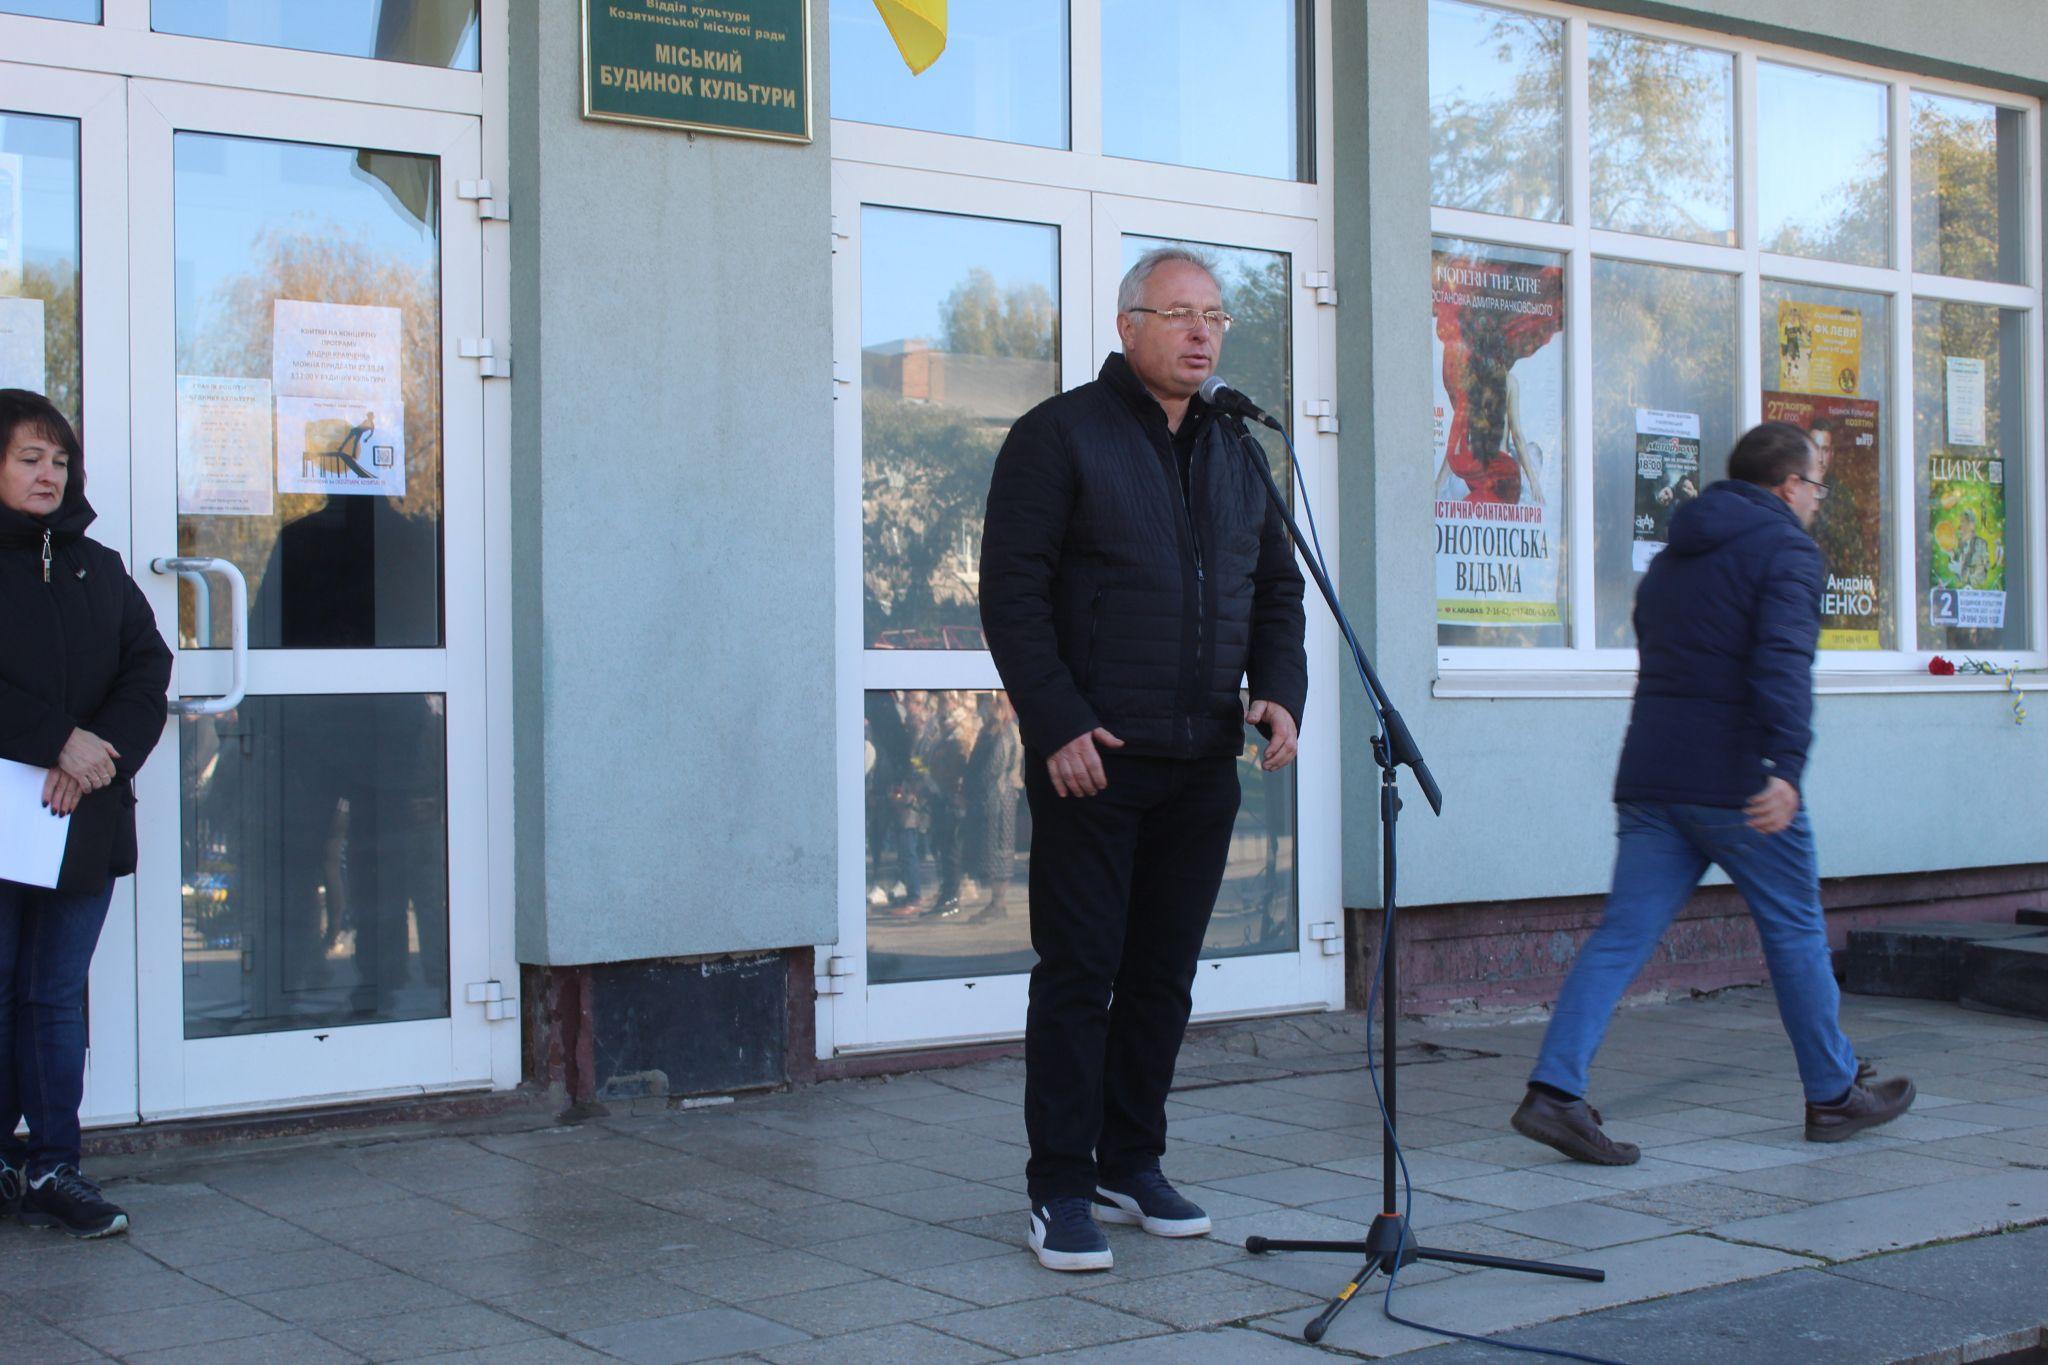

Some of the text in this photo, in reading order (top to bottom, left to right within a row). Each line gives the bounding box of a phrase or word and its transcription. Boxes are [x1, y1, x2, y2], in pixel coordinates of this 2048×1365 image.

[646, 0, 750, 22] Відділ культури
[609, 6, 786, 42] Козятинської міської ради
[656, 43, 742, 74] МІСЬКИЙ
[601, 65, 796, 109] БУДИНОК КУЛЬТУРИ
[1437, 266, 1542, 295] MODERN THEATRE
[1472, 295, 1499, 310] ДМИТРА
[1500, 299, 1553, 317] РАЧКОВСЬКОГО
[1933, 458, 1985, 481] ЦИРК
[1475, 503, 1542, 523] ФАНТАСМАГОРІЯ
[1456, 561, 1522, 598] ВІДЬМА
[1826, 573, 1873, 594] Андрій
[1940, 592, 1952, 616] 2
